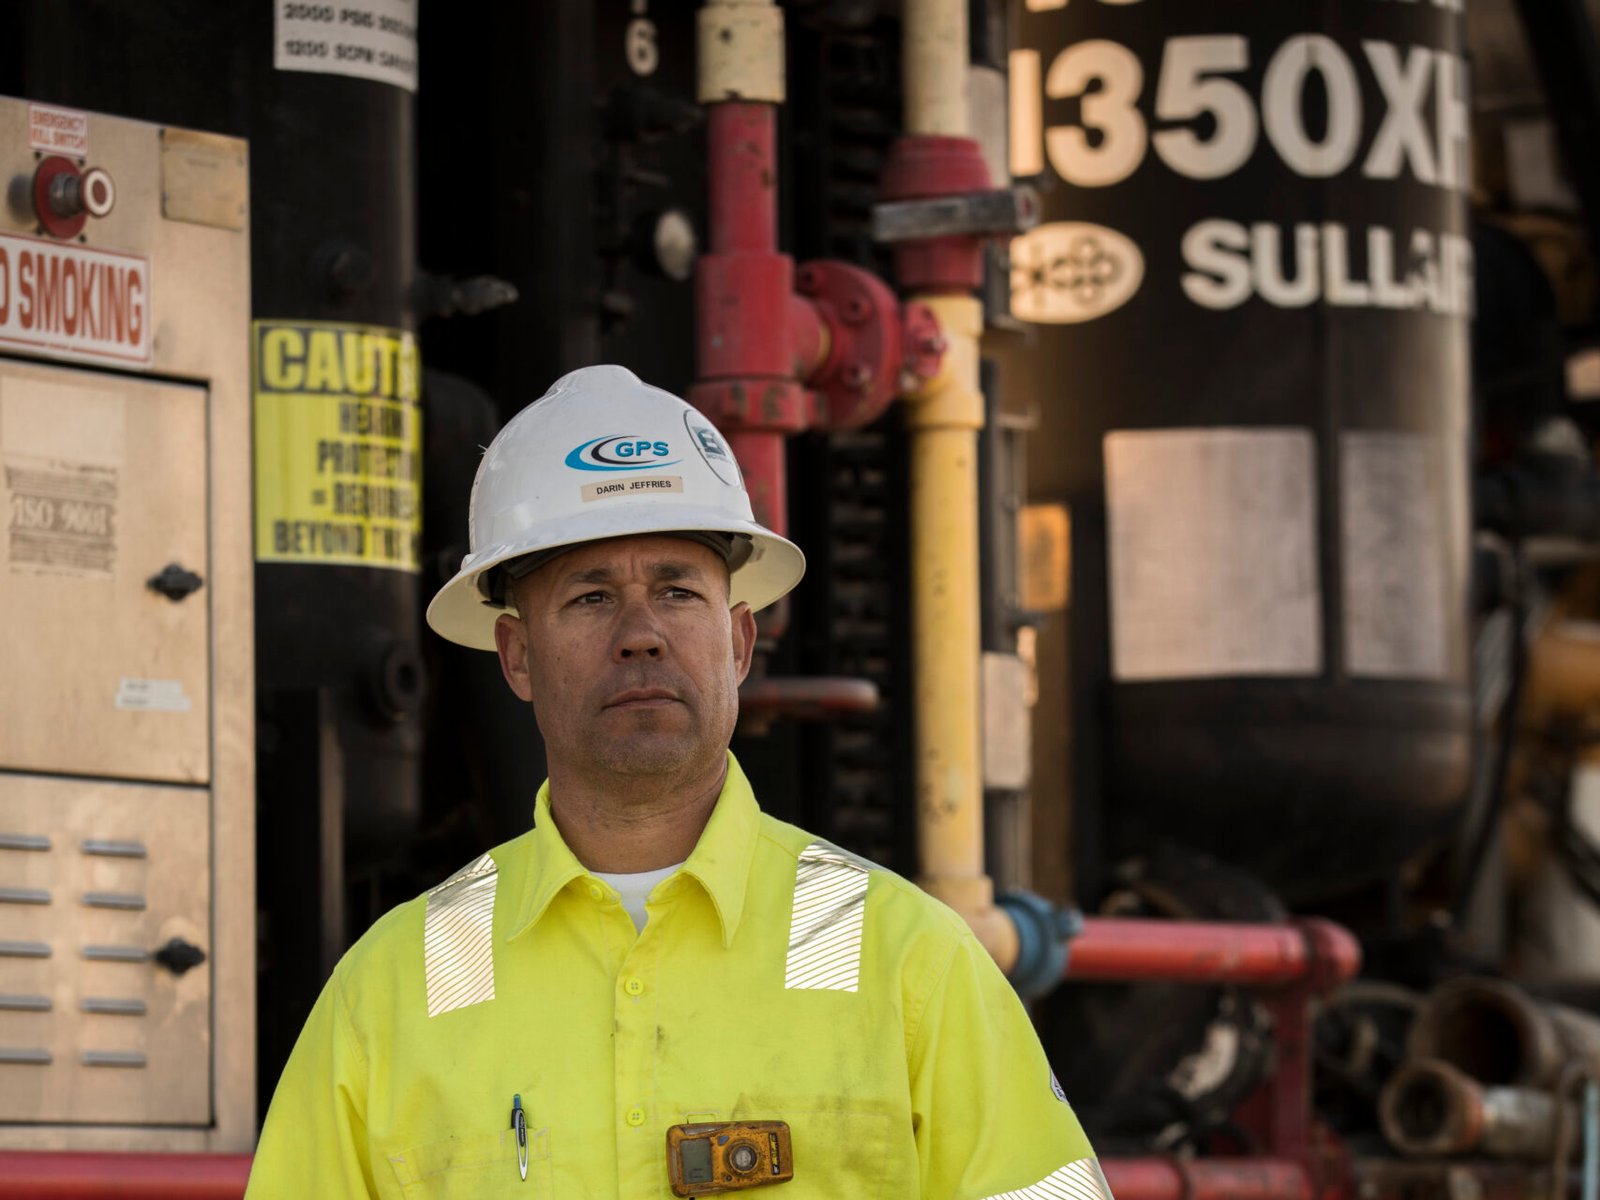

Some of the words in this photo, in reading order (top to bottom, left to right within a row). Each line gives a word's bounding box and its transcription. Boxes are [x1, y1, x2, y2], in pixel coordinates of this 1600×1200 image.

[18, 248, 143, 347] SMOKING
[615, 441, 669, 457] GPS
[596, 483, 625, 496] DARIN
[629, 480, 672, 491] JEFFRIES
